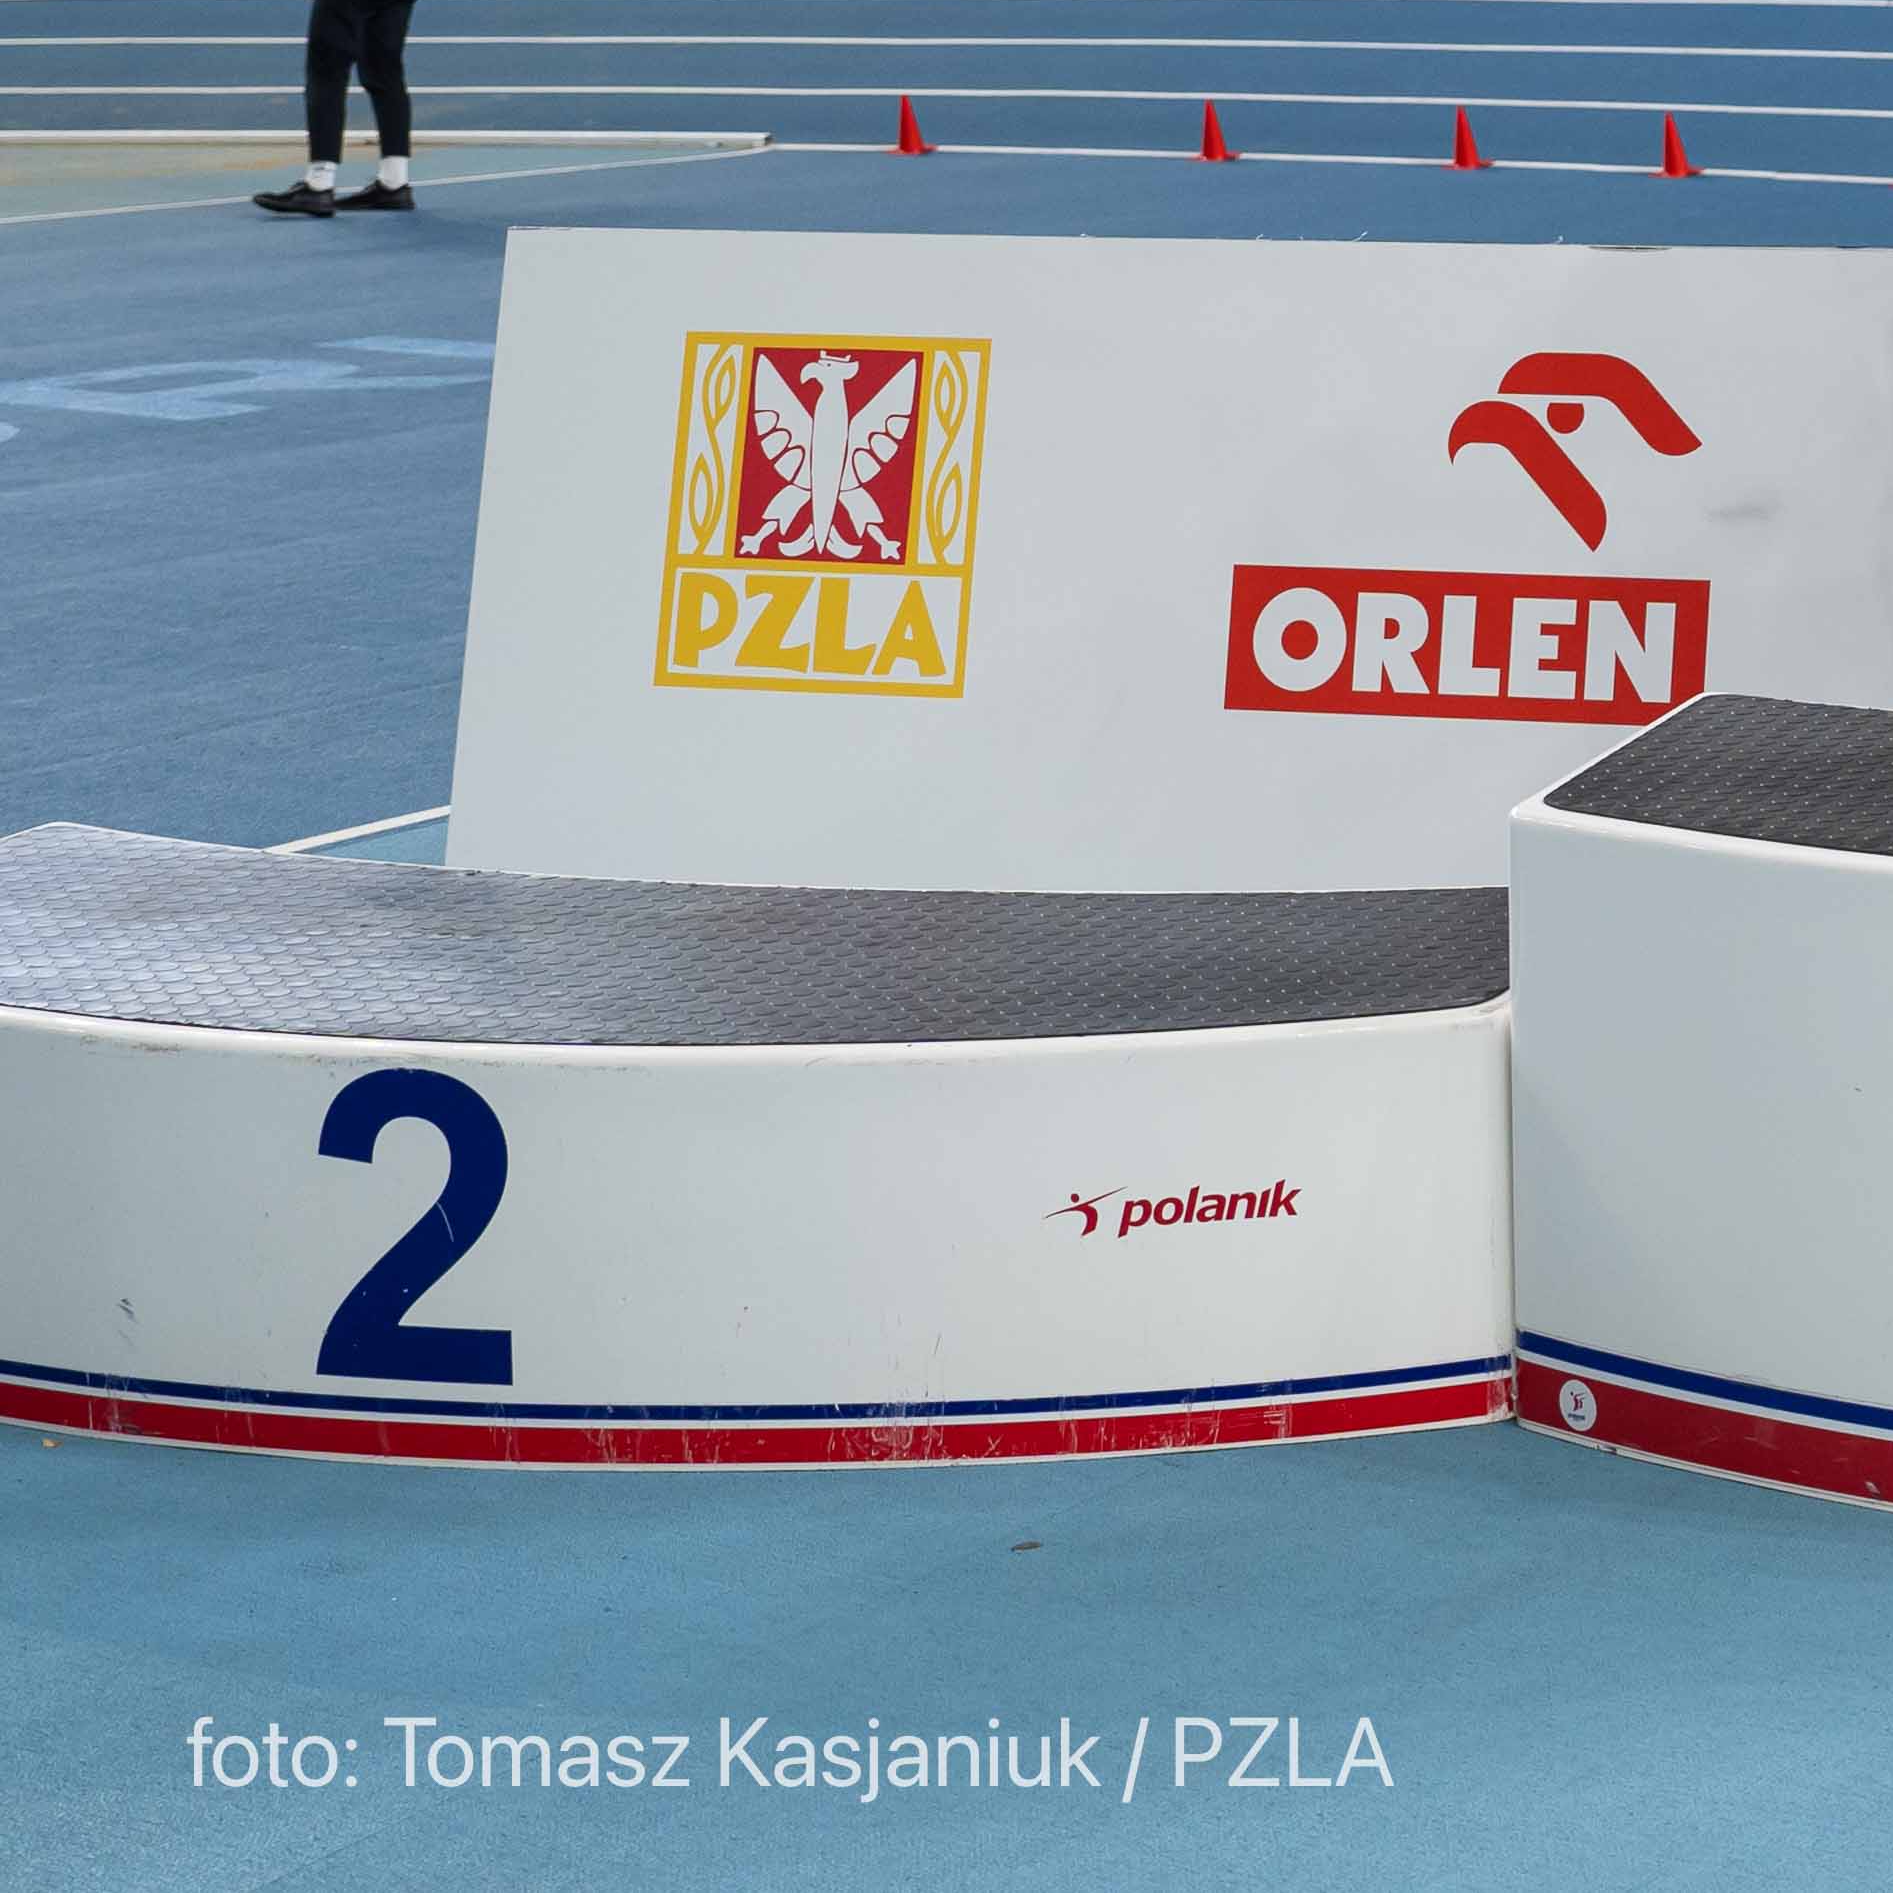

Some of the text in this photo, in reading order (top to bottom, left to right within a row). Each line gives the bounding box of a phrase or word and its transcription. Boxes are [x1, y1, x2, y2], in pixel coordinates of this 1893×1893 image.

[673, 571, 947, 677] PZLA
[1252, 586, 1677, 704] ORLEN
[316, 1067, 514, 1387] 2
[1117, 1178, 1303, 1238] polanik
